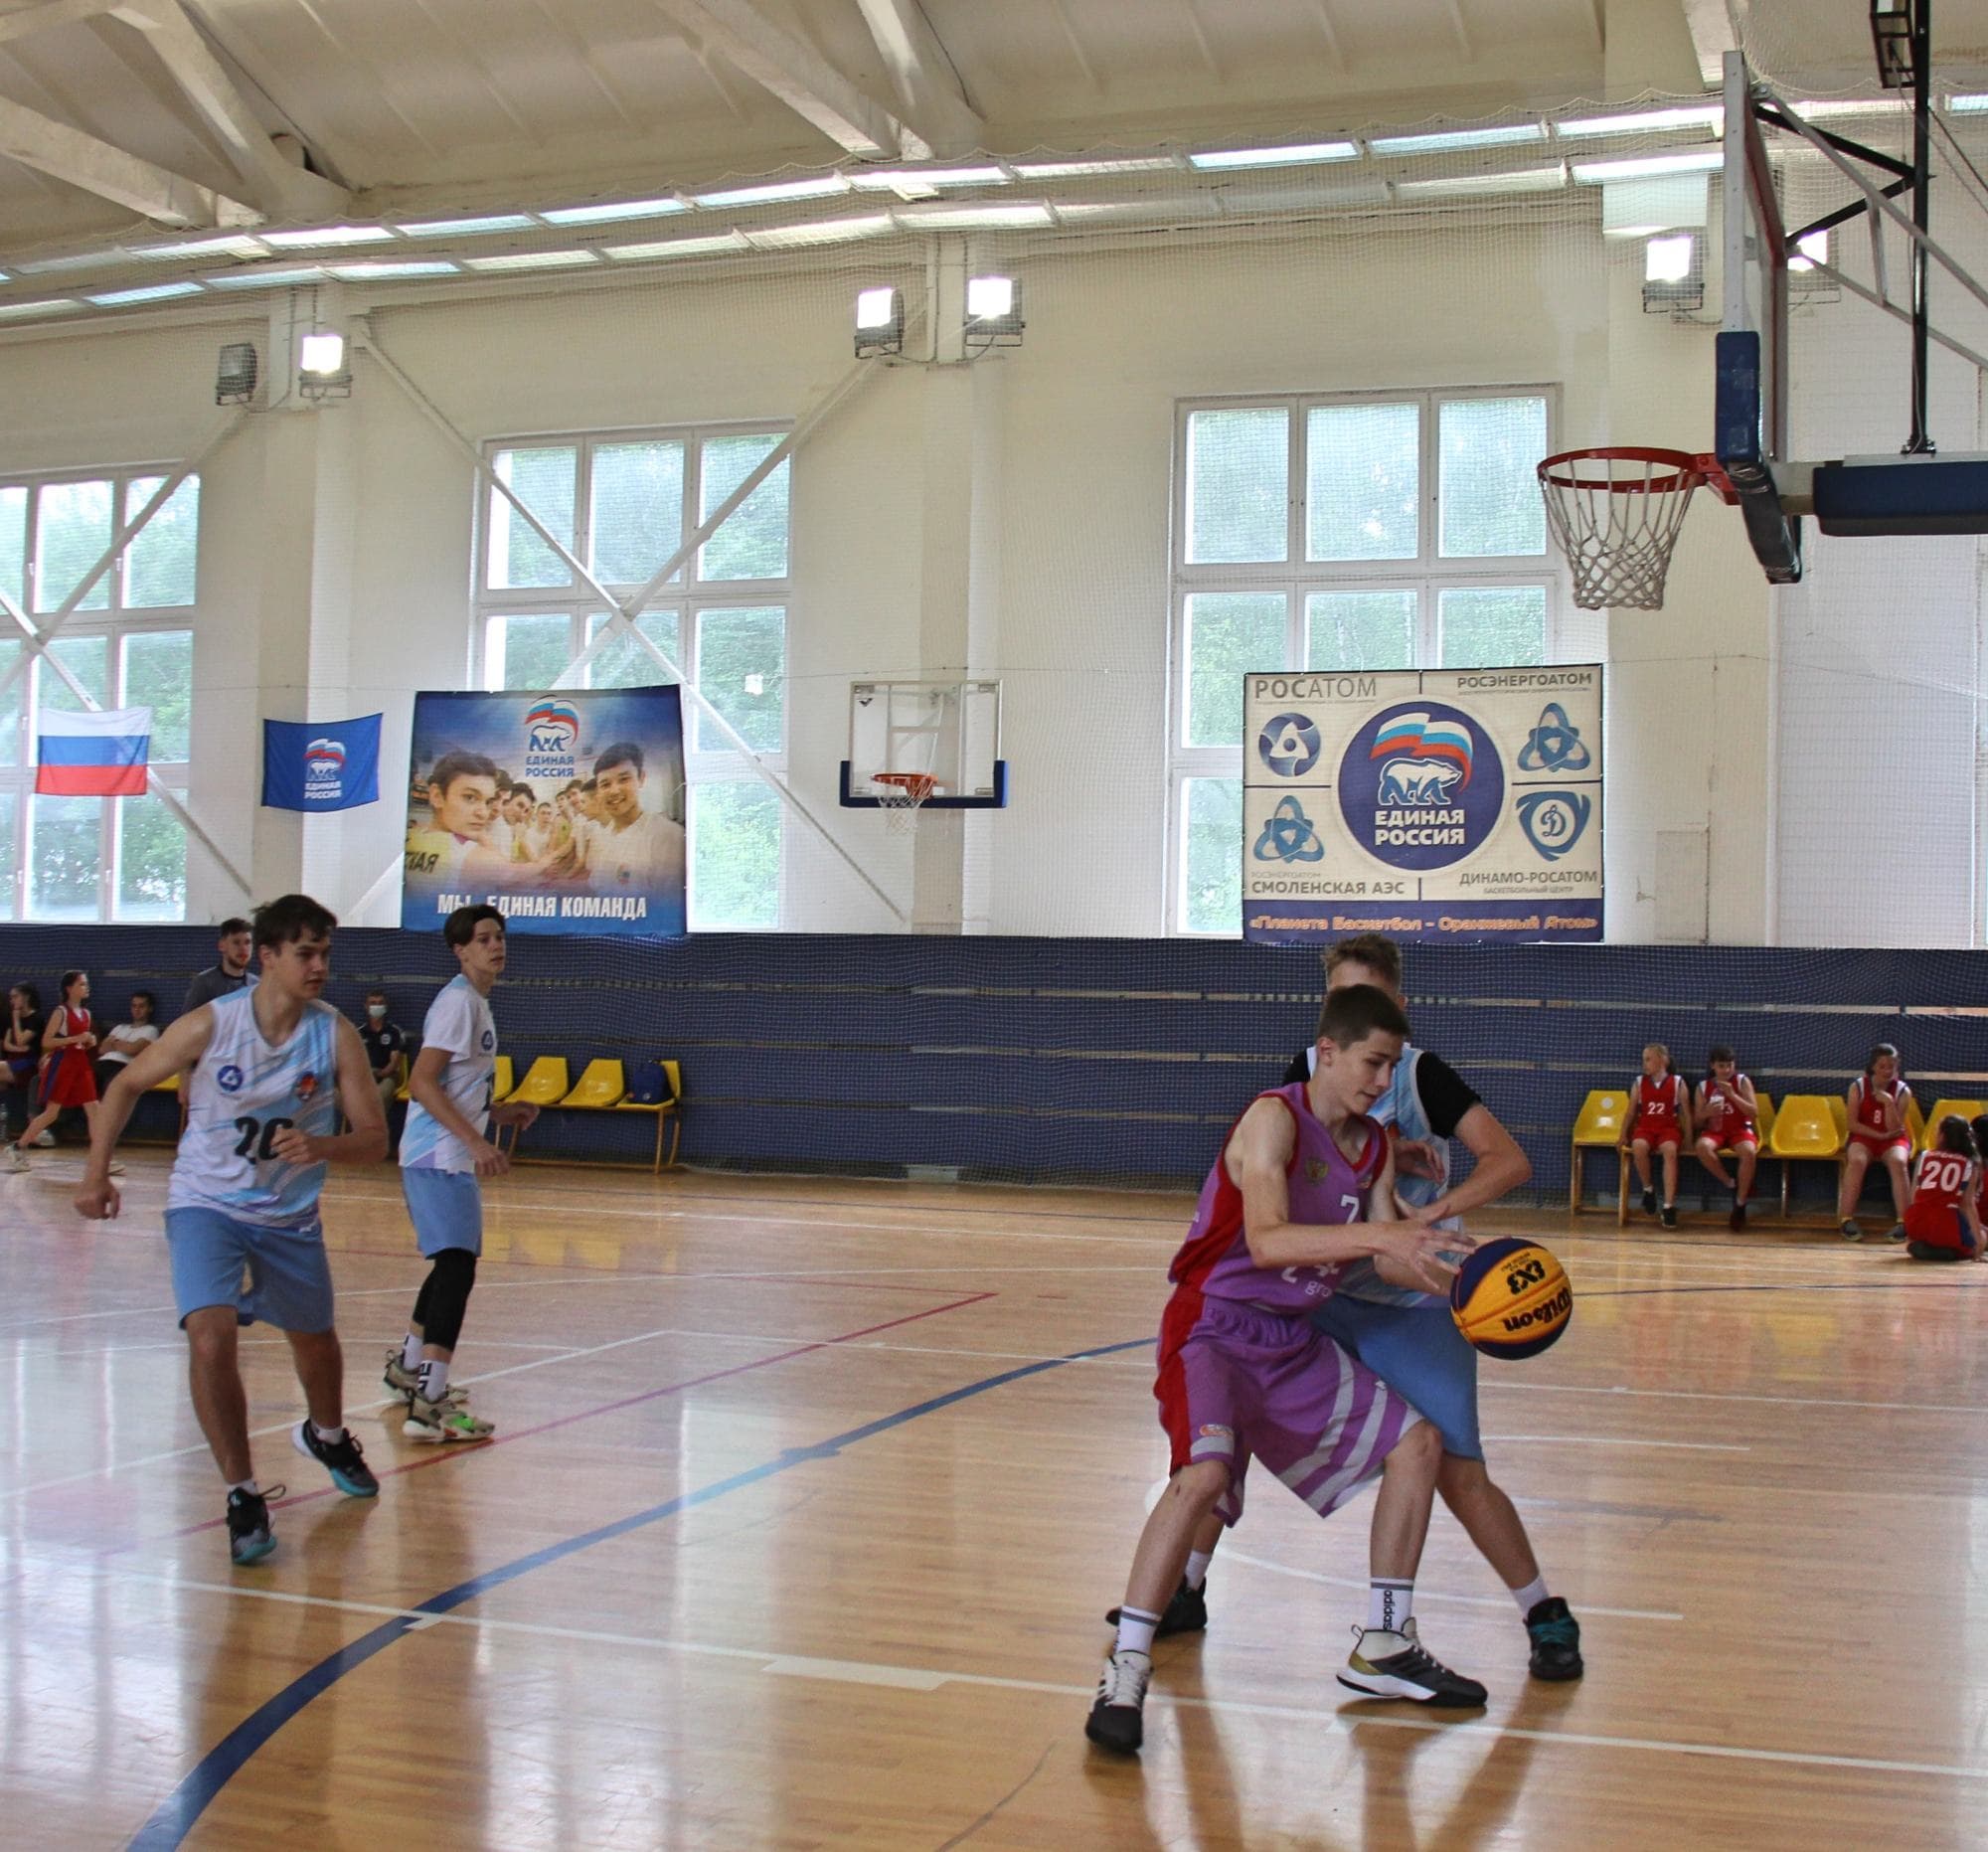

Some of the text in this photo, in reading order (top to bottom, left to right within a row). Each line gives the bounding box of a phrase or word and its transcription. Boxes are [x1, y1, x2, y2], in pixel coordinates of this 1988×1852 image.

[1255, 678, 1377, 699] РОСАТОМ
[1457, 673, 1592, 688] РОСЭНЕРГОАТОМ
[526, 756, 574, 765] ЕДИНАЯ
[526, 767, 574, 777] РОССИЯ
[1375, 809, 1465, 828] ЕДИНАЯ
[1375, 828, 1465, 846] РОССИЯ
[1459, 871, 1597, 887] ДИНАМО-РОСАТОМ
[1251, 881, 1405, 895] СМОЛЕНСКАЯ АЭС
[486, 896, 556, 919] ЕДИНАЯ
[561, 897, 646, 921] КОМАНДА
[1647, 1101, 1665, 1114] 22
[1920, 1160, 1961, 1192] 20
[1383, 1591, 1396, 1630] adidas
